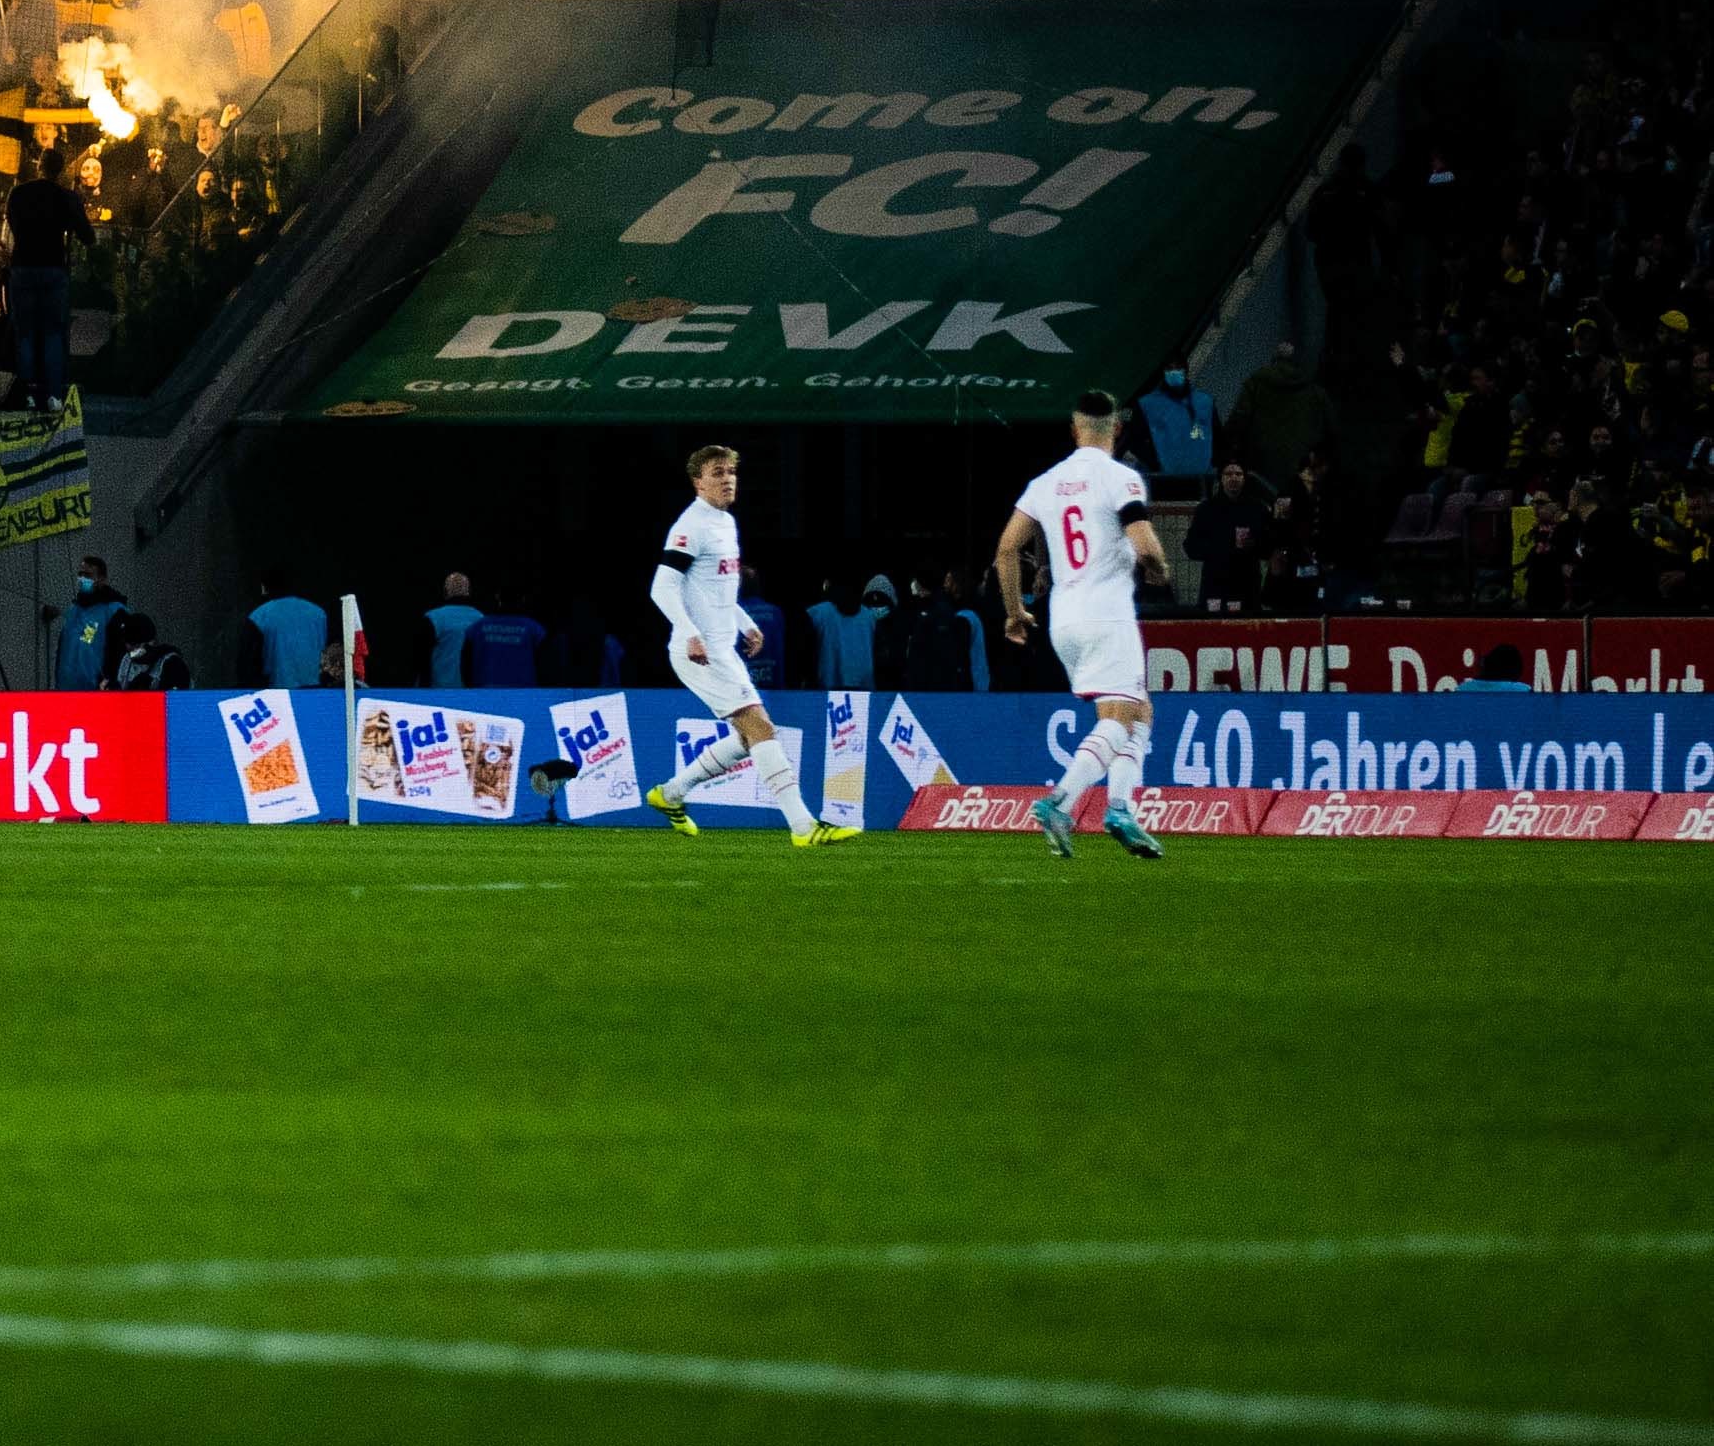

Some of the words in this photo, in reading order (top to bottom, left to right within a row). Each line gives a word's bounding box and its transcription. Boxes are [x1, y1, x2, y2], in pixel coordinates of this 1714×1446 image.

[573, 84, 1021, 139] Come
[1045, 85, 1281, 131] on,
[619, 148, 1151, 246] FC!
[433, 300, 1099, 362] DEVK
[616, 374, 780, 392] Getan.
[804, 371, 1053, 391] Geholfen.
[1062, 505, 1089, 571] 6
[230, 697, 273, 746] ja!
[396, 710, 449, 766] ja!
[558, 709, 610, 771] ja!
[828, 692, 854, 740] ja!
[890, 714, 915, 746] ja!
[1171, 708, 1255, 788] 40
[1272, 710, 1477, 791] Jahren
[1498, 740, 1626, 792] vom
